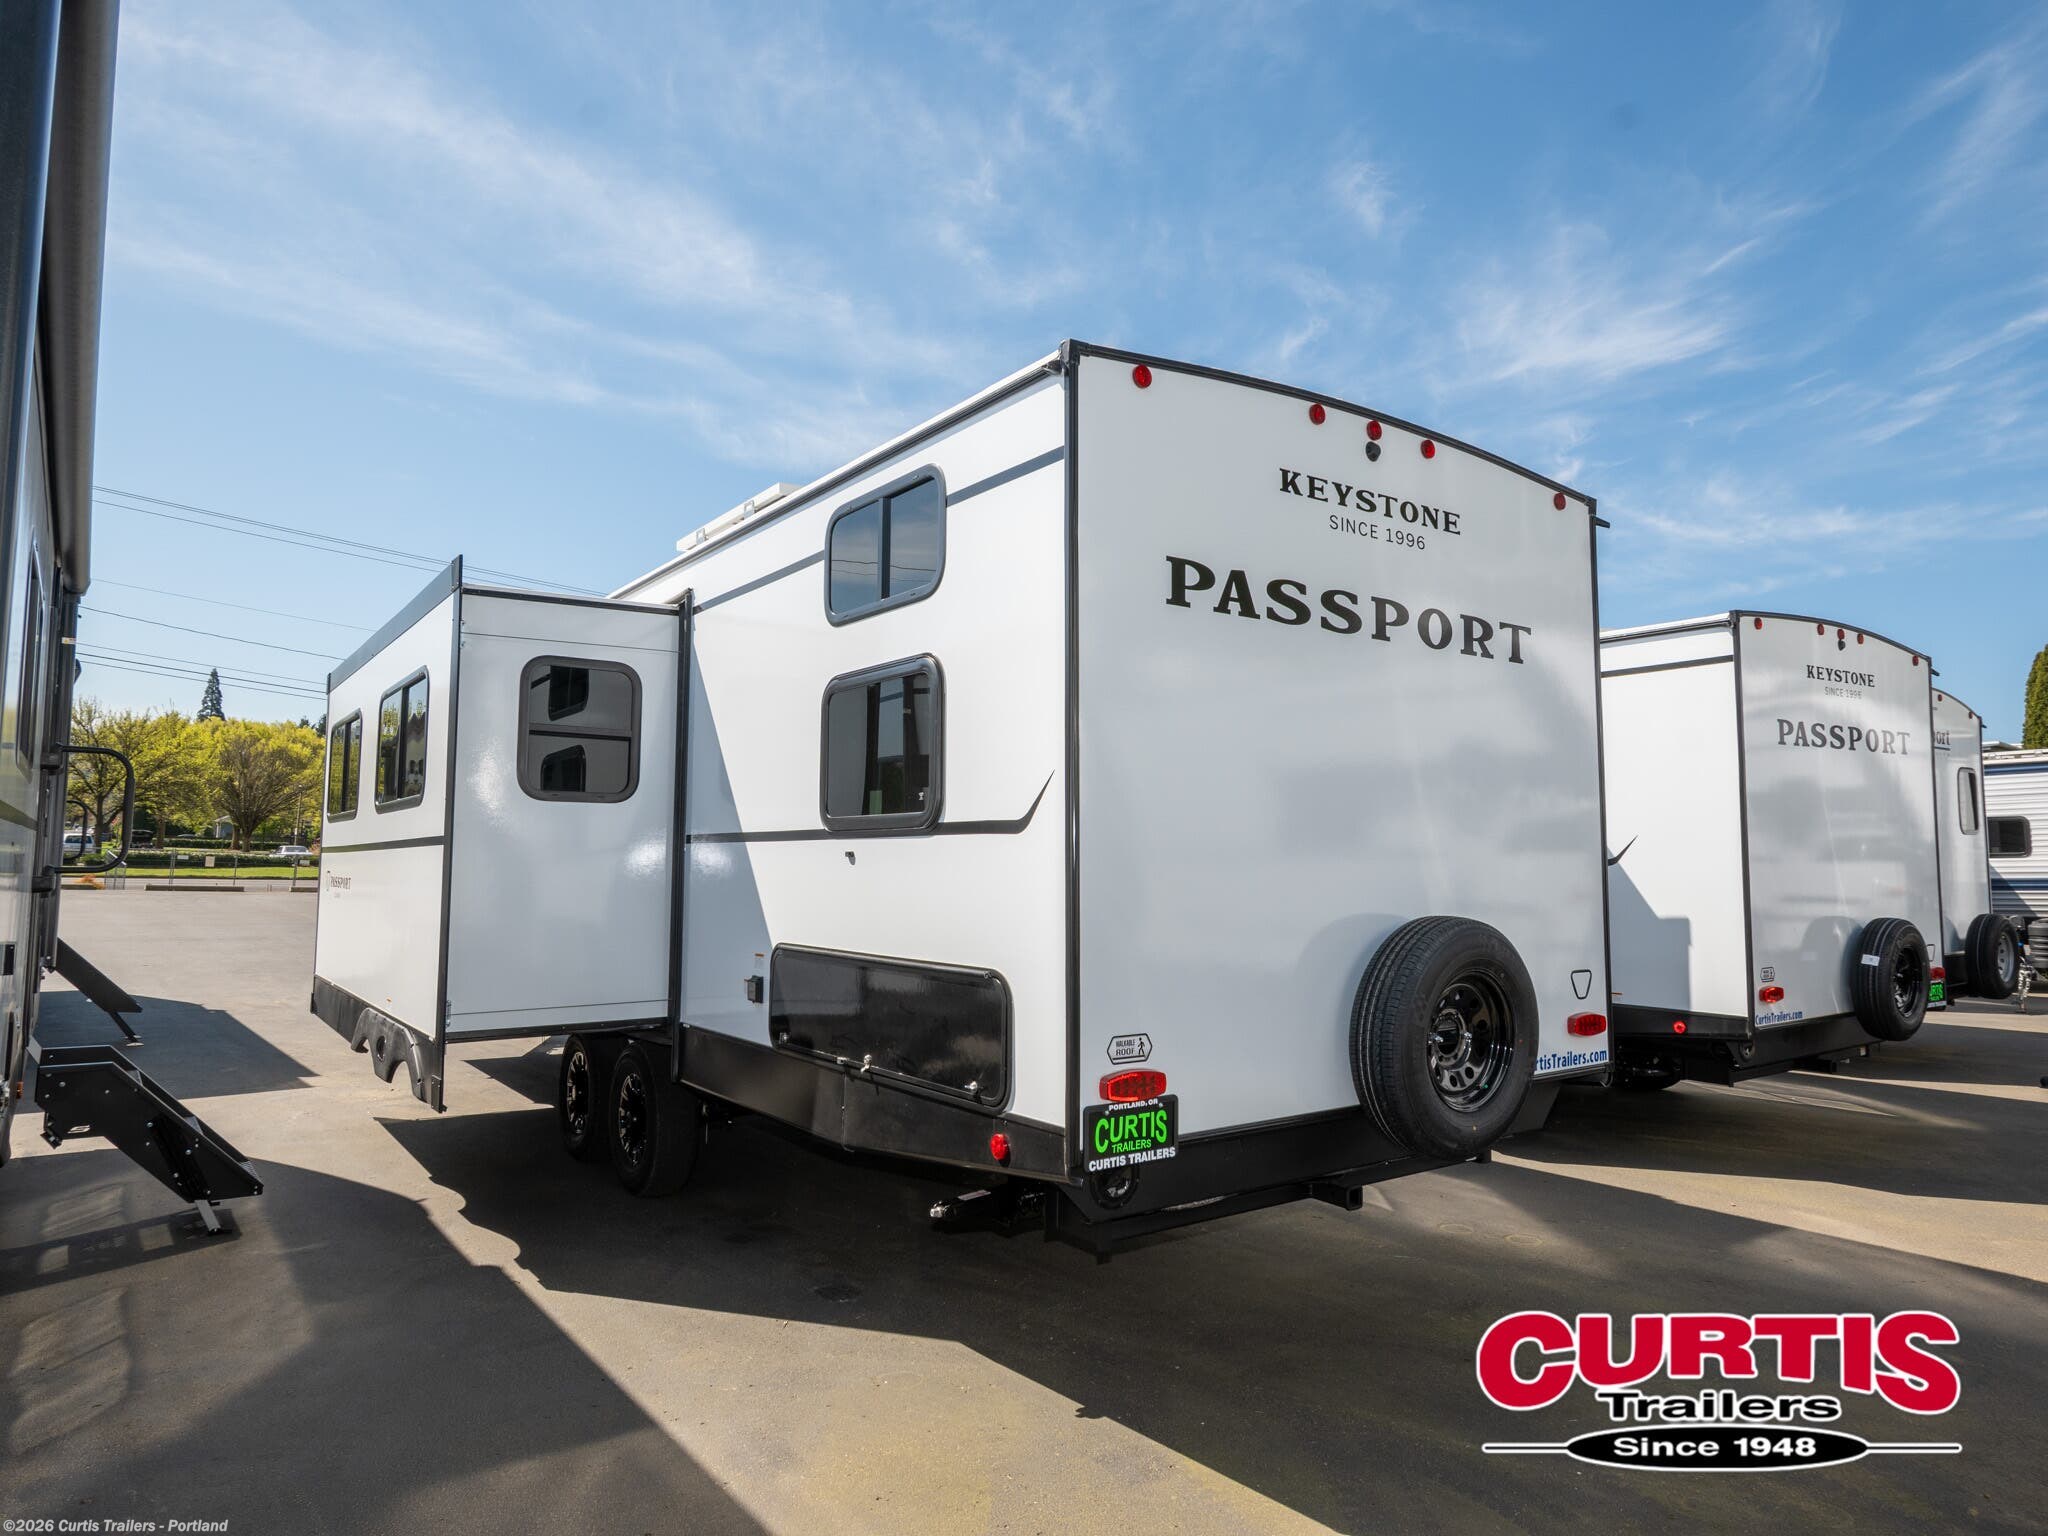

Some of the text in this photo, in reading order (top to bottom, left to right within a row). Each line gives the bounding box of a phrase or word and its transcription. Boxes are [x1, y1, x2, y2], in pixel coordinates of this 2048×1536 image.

[1279, 468, 1461, 535] KEYSTONE
[1329, 515, 1426, 550] SINCE 1996
[1165, 555, 1532, 664] PASSPORT
[1806, 664, 1875, 687] KEYSTONE
[1777, 718, 1910, 755] PASSPORT
[1095, 1110, 1167, 1153] CURTIS
[1111, 1139, 1152, 1154] TRAILERS
[1089, 1147, 1176, 1172] CURTIS TRAILERS
